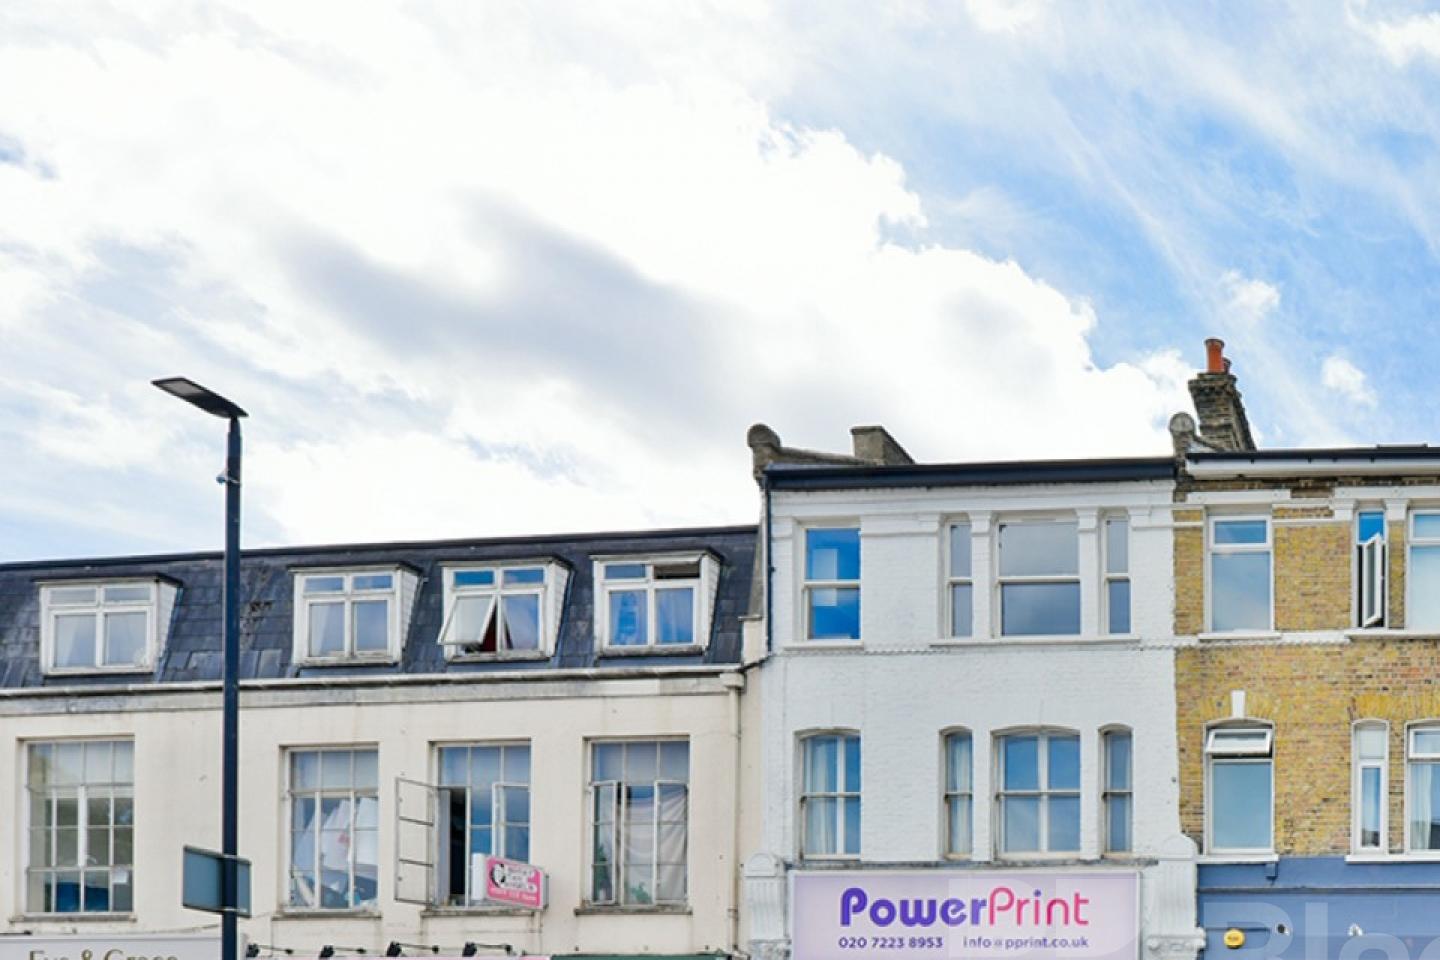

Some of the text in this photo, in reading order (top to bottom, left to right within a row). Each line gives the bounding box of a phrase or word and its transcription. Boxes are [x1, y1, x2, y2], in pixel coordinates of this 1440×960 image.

[840, 887, 1089, 927] PowerPrint
[838, 936, 868, 949] 020
[871, 936, 905, 949] 7223
[908, 936, 943, 949] 8953
